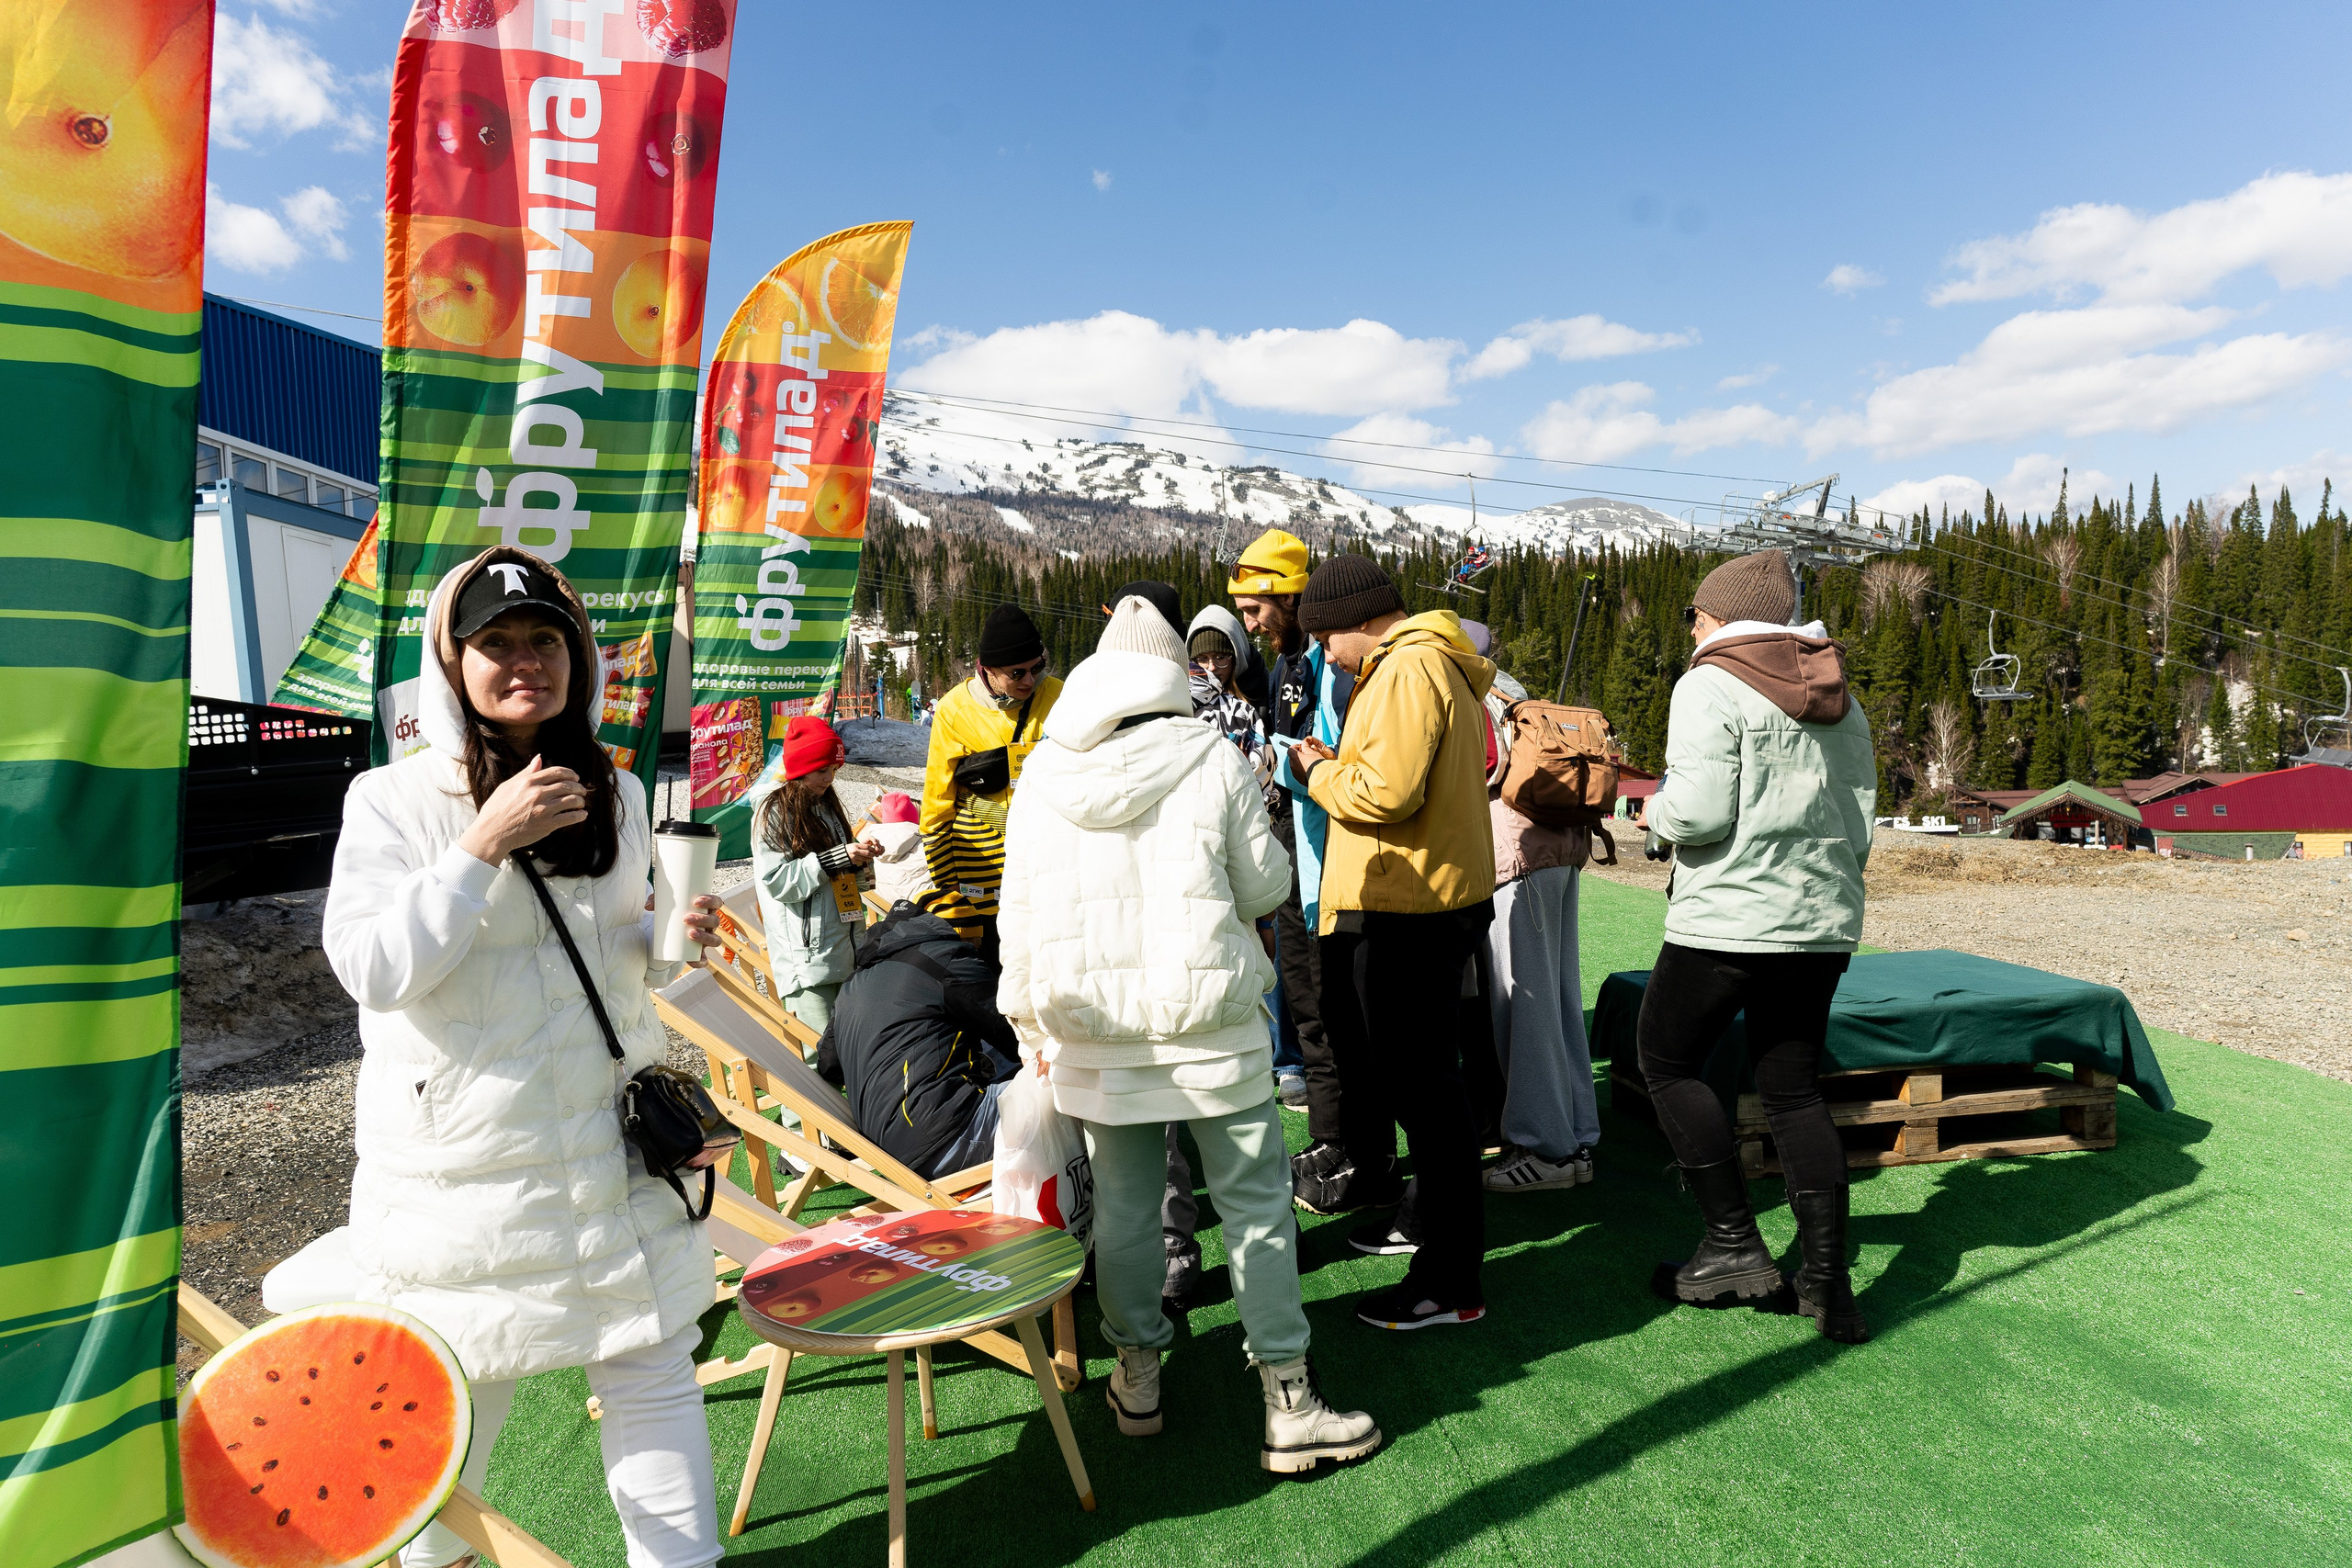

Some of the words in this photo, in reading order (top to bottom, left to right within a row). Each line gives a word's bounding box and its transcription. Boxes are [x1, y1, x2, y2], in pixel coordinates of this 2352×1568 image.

[476, 0, 623, 564] фрутилад
[736, 329, 831, 651] фрутилад
[582, 589, 668, 613] рекусы
[397, 616, 425, 635] дл
[693, 662, 770, 677] здоровые
[774, 664, 839, 679] перекус
[297, 672, 363, 700] здоровые
[692, 678, 718, 689] для
[721, 677, 756, 690] всей
[761, 680, 806, 690] семьи
[287, 682, 315, 697] для
[316, 693, 348, 707] всей
[348, 702, 373, 713] сем
[603, 698, 639, 715] тилад
[1922, 816, 1946, 827] SKI
[834, 1232, 1012, 1292] фрутилад
